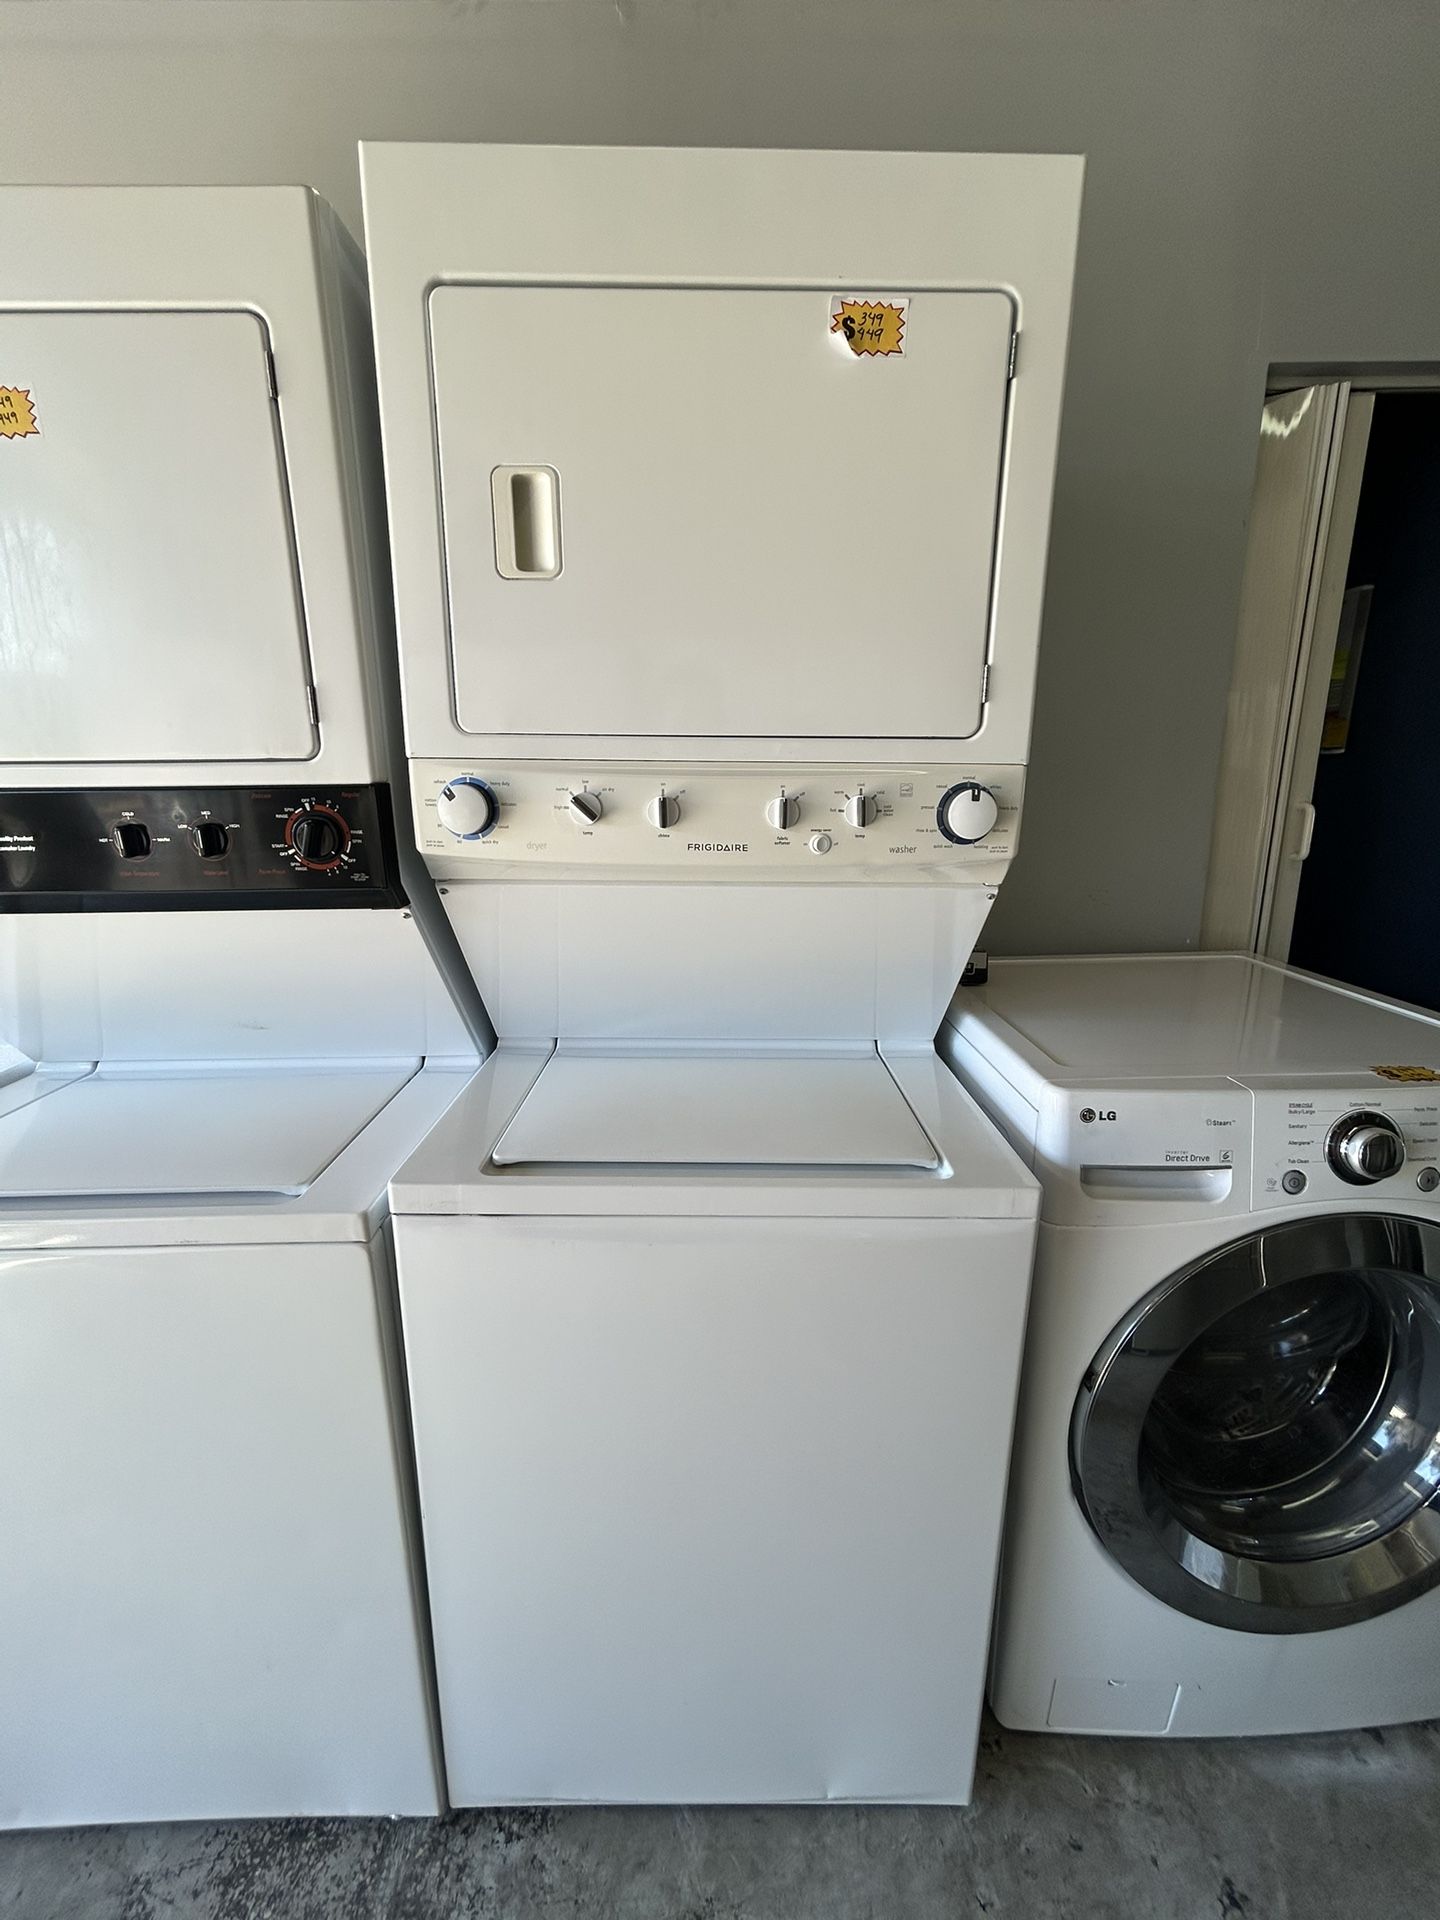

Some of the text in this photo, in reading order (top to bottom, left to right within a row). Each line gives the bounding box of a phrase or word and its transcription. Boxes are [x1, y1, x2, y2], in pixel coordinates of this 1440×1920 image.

[858, 312, 884, 326] 349
[527, 841, 547, 852] dryer
[687, 843, 749, 852] FRIGIDAIRE
[889, 844, 917, 854] washer
[1098, 1110, 1117, 1121] LG
[1165, 1154, 1210, 1162] Direct Drive
